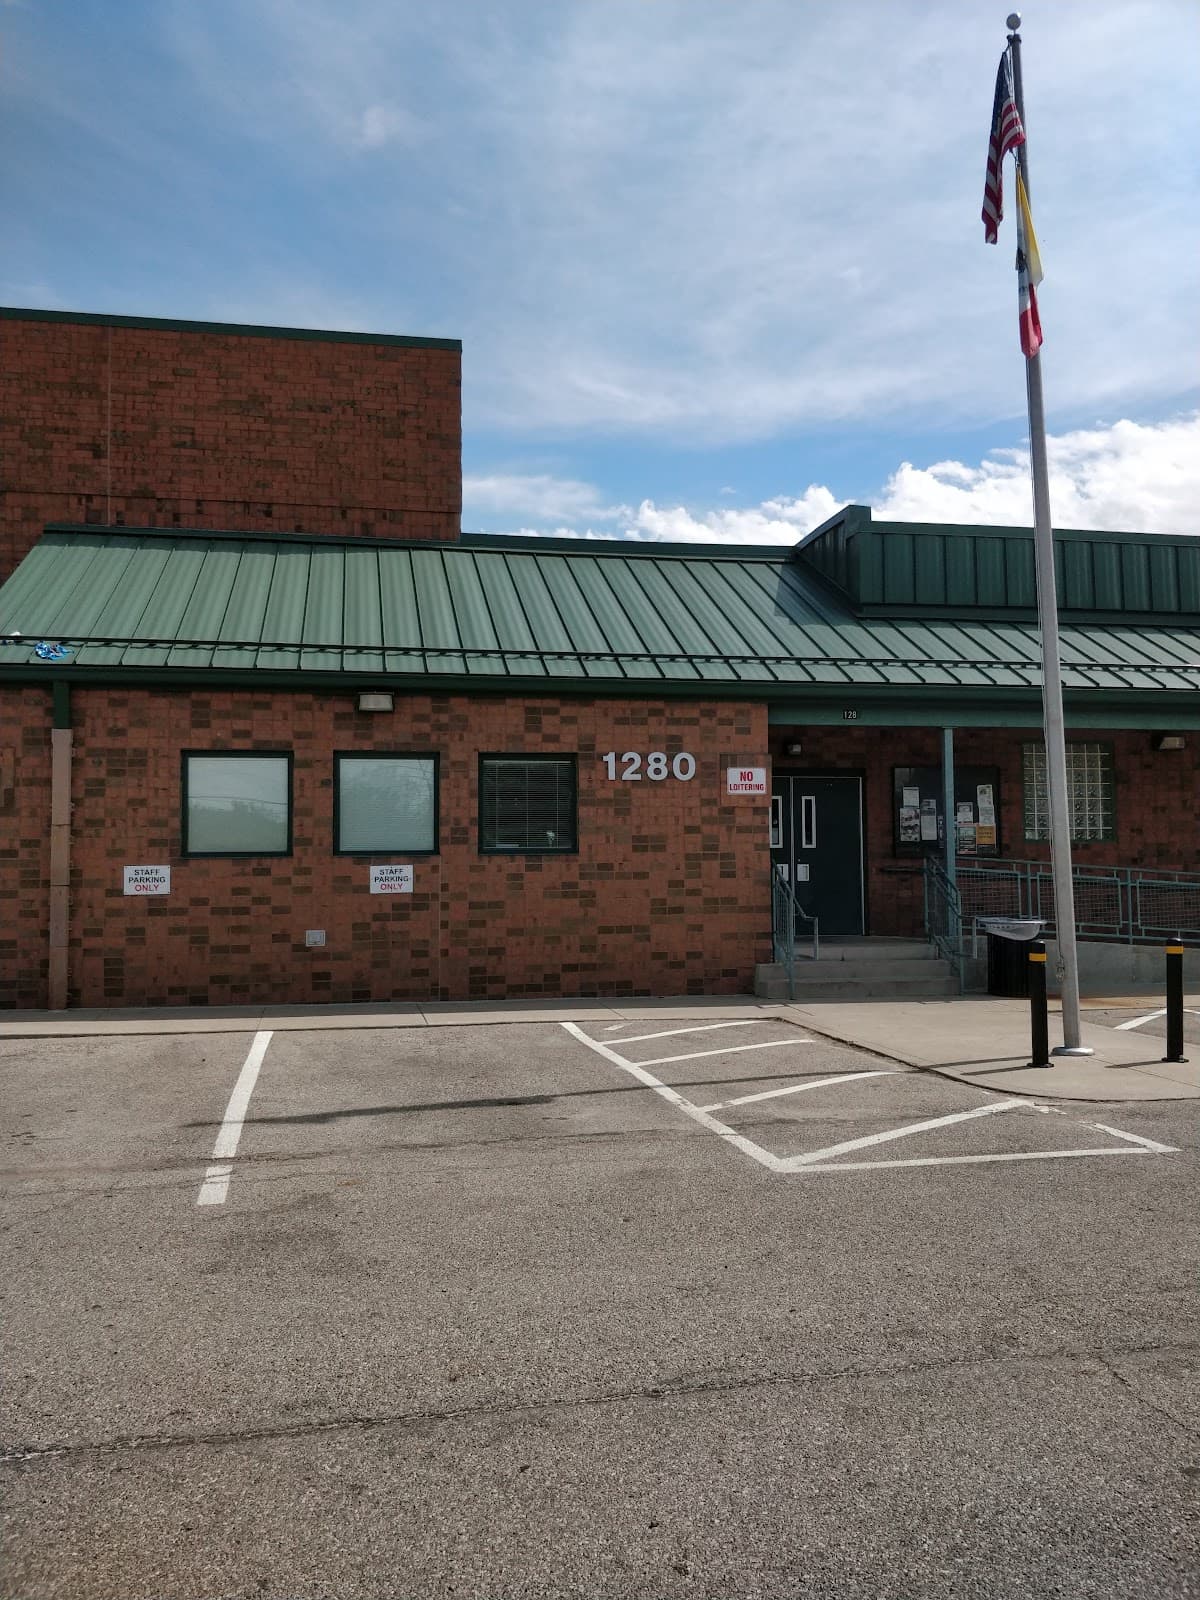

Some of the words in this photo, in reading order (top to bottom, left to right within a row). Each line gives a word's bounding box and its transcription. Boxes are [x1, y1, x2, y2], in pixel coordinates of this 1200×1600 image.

[602, 751, 696, 781] 1280
[740, 771, 753, 782] NO
[729, 783, 765, 791] LOITERING
[374, 875, 409, 883] PARKING
[134, 884, 160, 892] ONLY
[380, 883, 403, 891] ONLY
